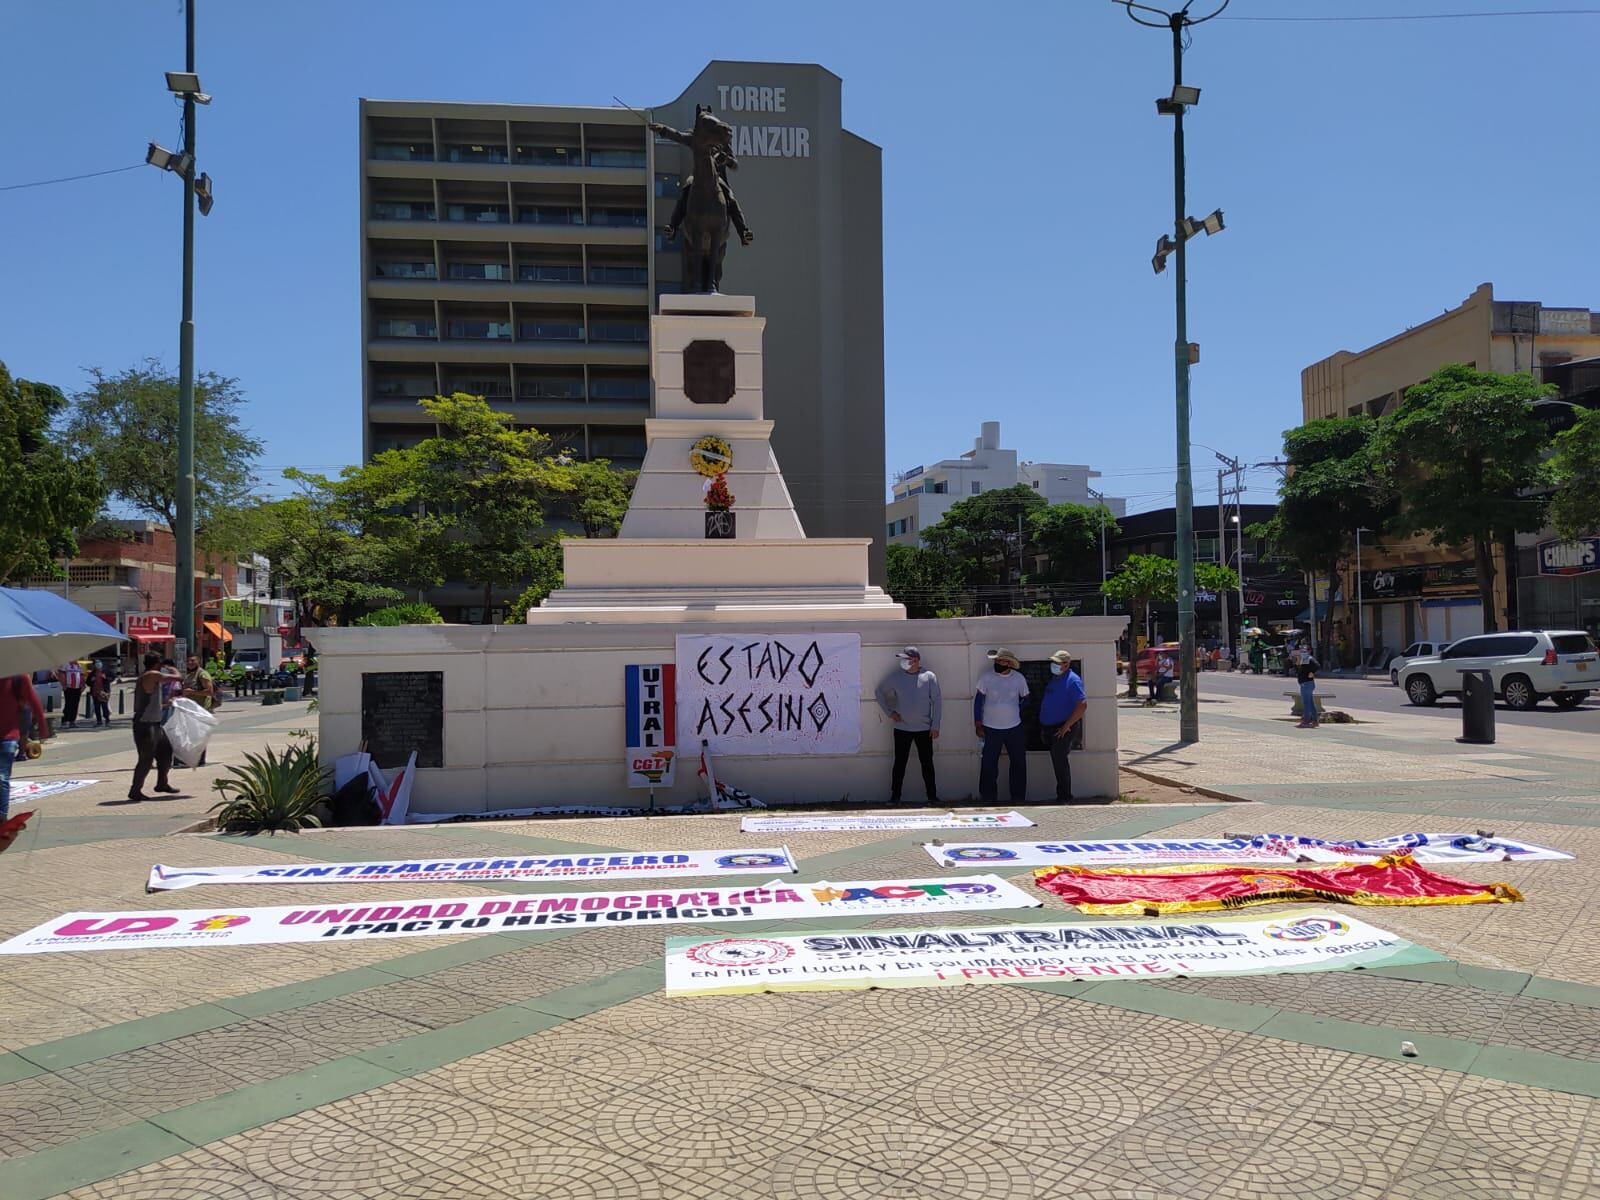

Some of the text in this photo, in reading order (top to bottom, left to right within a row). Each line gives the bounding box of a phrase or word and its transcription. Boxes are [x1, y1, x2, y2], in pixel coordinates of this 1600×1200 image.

[718, 85, 786, 112] TORRE
[1544, 543, 1595, 567] CHAMPS
[697, 641, 823, 688] ESTADO
[643, 668, 662, 747] UTRAL
[697, 692, 831, 736] ASESINO
[633, 759, 664, 770] CGT
[256, 855, 690, 877] SINTRACORPACERO
[399, 870, 457, 878] VALEN
[462, 868, 505, 876] MAS
[593, 863, 700, 871] GANANCIAS
[279, 888, 804, 925] UNIDAD DEMOCRATICA
[502, 907, 754, 926] HISTORICO!
[54, 917, 178, 936] UD
[109, 931, 232, 939] DEMOCRATICA
[803, 924, 1247, 951] SINALTRAINAL
[692, 970, 717, 978] EN
[727, 968, 761, 977] PIE
[803, 963, 868, 973] LUCHA
[878, 963, 888, 971] Y
[897, 961, 923, 969] EN
[929, 957, 1064, 968] SOLIDARIDAD
[1069, 955, 1109, 964] CON
[1116, 954, 1144, 962] EL
[960, 962, 1171, 979] PRESENTE
